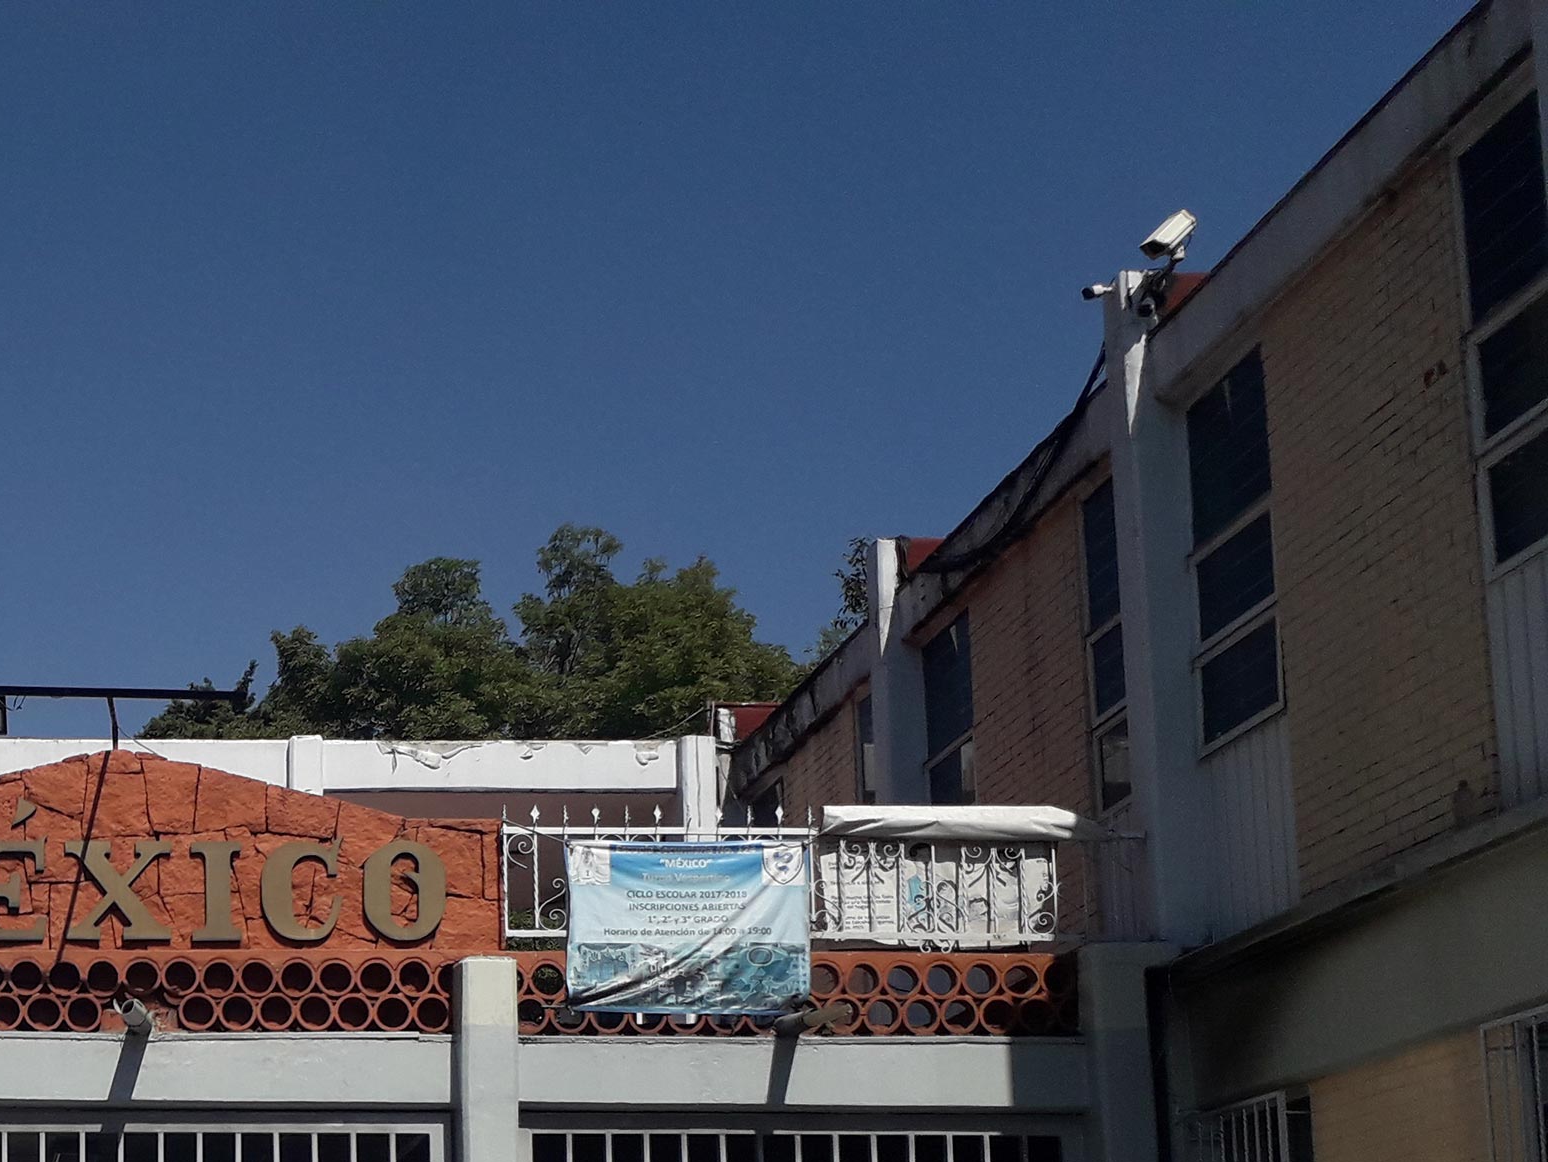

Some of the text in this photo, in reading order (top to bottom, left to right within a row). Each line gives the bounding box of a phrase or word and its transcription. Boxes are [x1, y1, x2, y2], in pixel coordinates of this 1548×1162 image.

[626, 890, 652, 898] CICLO
[655, 890, 697, 899] ESCOLAR
[628, 902, 747, 911] INSCRIPCIONES ABIERTAS
[693, 915, 729, 924] GRADO
[603, 927, 638, 936] Horario
[640, 927, 652, 936] de
[654, 927, 696, 936] Atención
